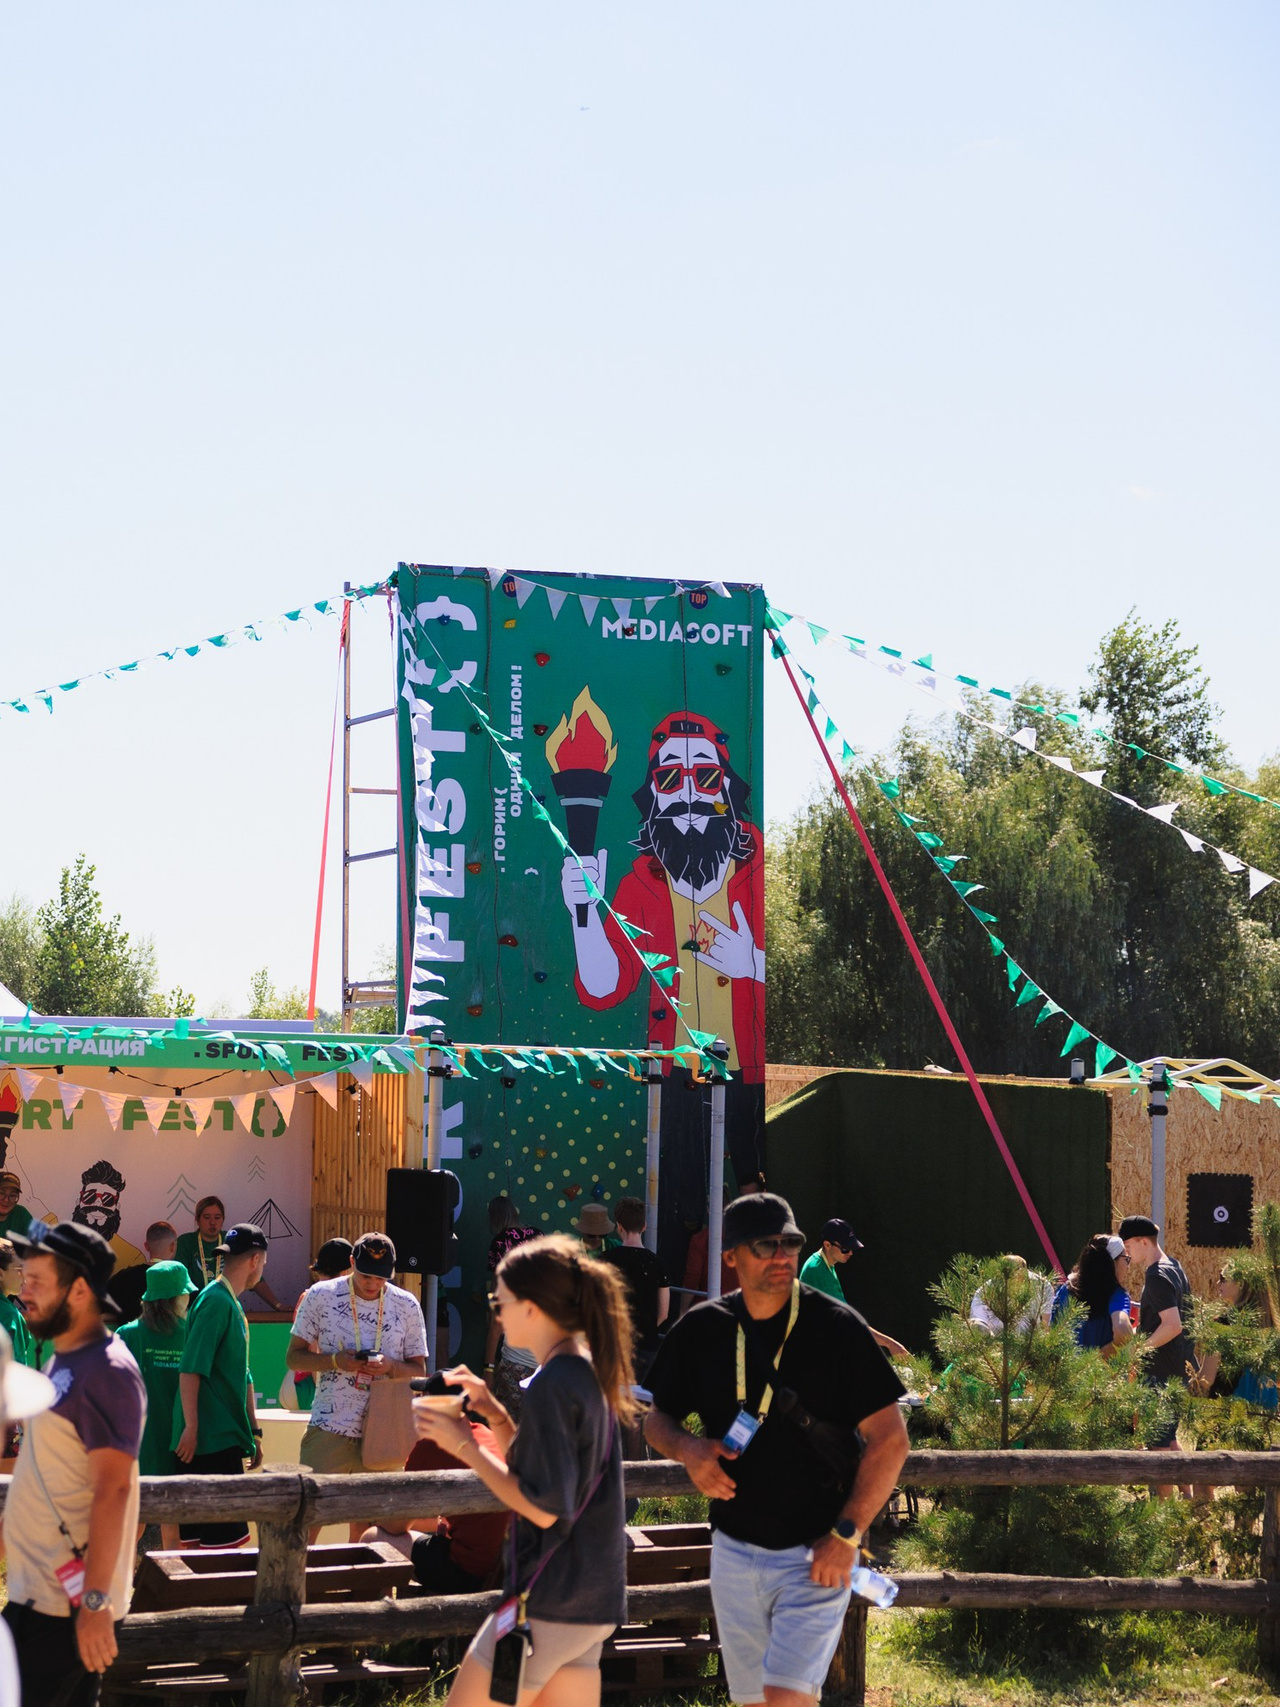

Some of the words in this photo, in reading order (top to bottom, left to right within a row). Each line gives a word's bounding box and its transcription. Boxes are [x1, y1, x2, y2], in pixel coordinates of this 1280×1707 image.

[504, 582, 515, 593] TO
[690, 593, 707, 604] TOP
[510, 665, 524, 739] ДЕЛОМ!
